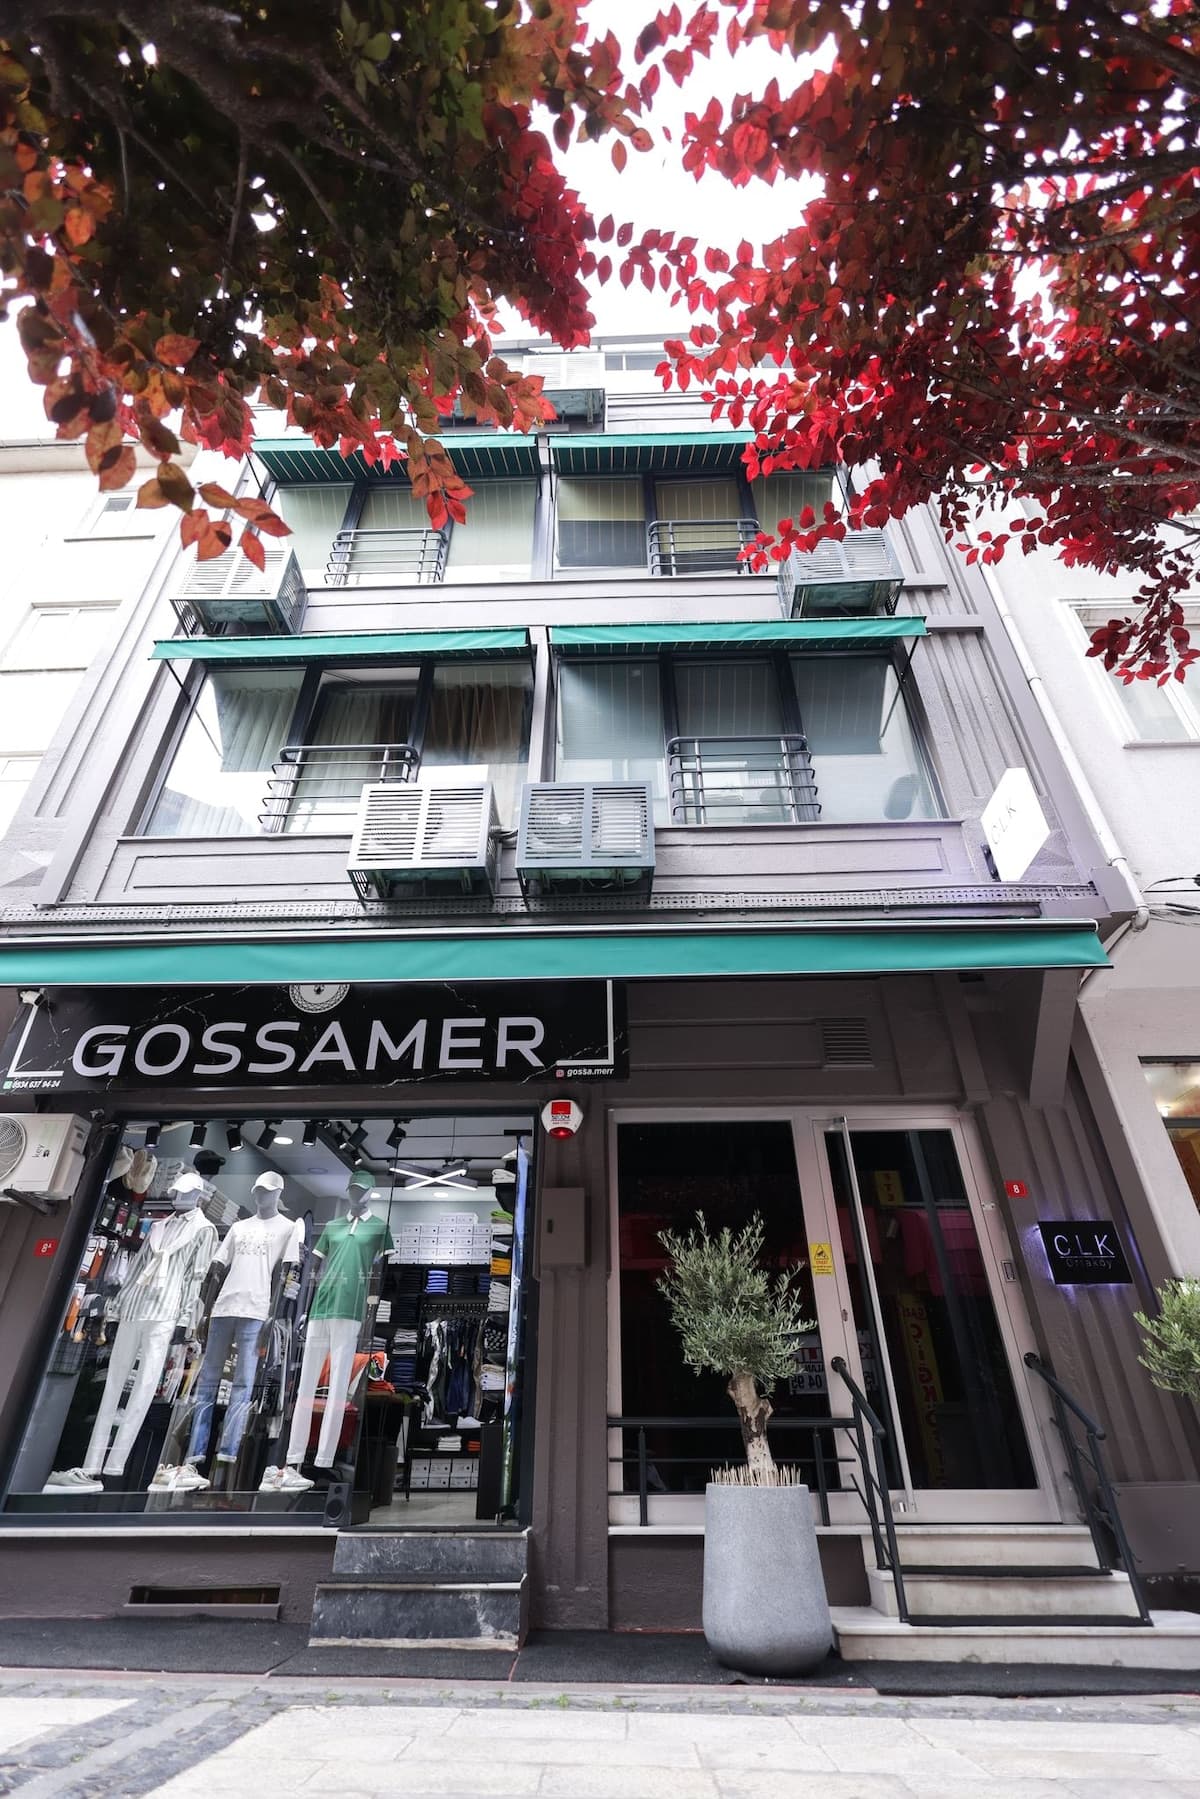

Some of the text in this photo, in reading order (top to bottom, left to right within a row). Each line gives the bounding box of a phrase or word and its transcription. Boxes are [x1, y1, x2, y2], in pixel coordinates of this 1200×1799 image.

[72, 1016, 545, 1077] GOSSAMER
[1012, 1184, 1020, 1194] 8
[1054, 1234, 1115, 1256] CLK
